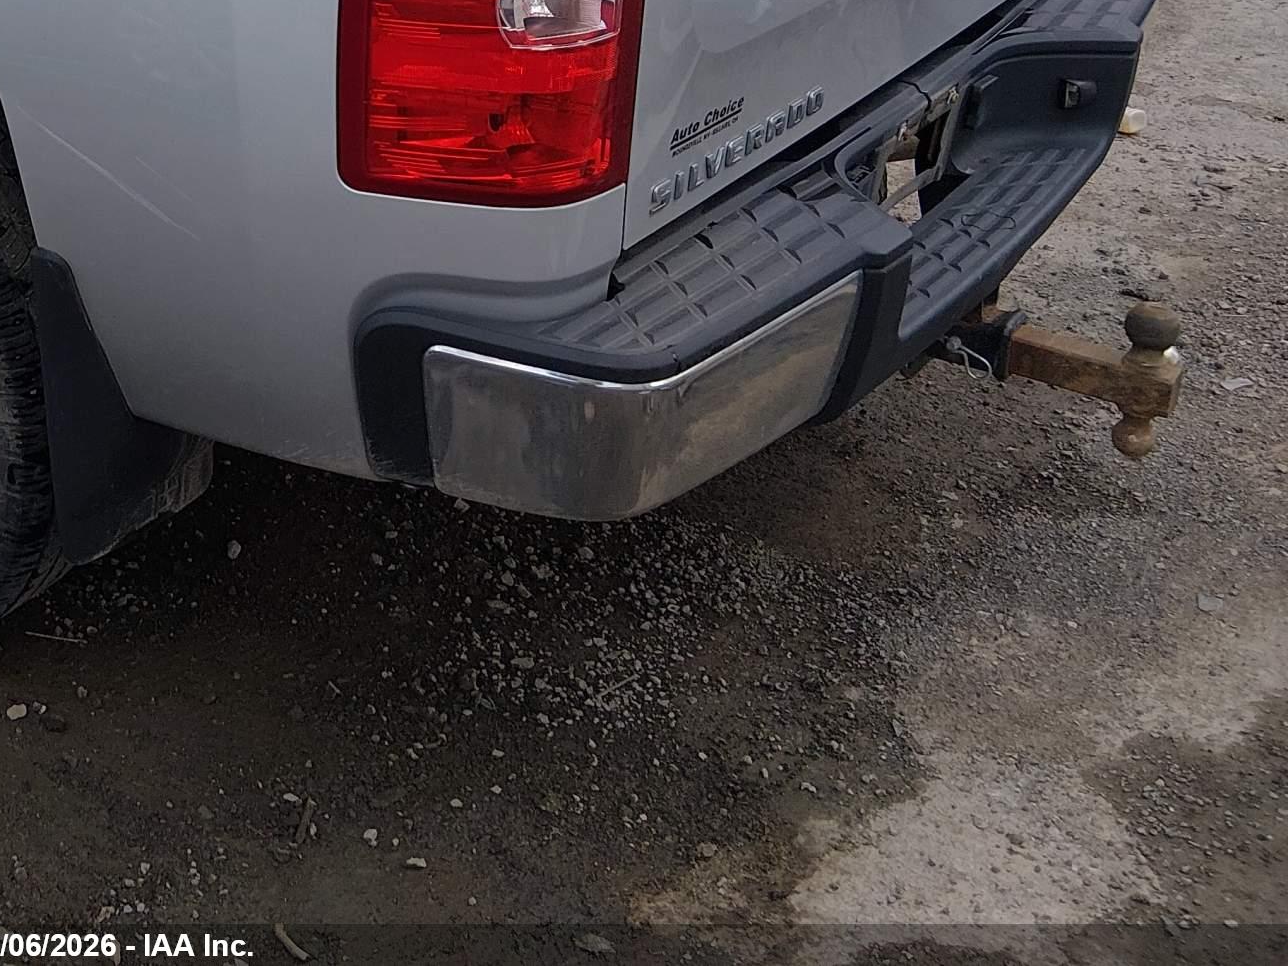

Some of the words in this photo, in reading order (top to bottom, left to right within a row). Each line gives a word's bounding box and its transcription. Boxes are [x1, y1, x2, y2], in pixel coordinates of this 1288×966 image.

[650, 86, 824, 215] SILVERADO
[670, 121, 700, 145] Auto
[704, 96, 745, 126] Choice
